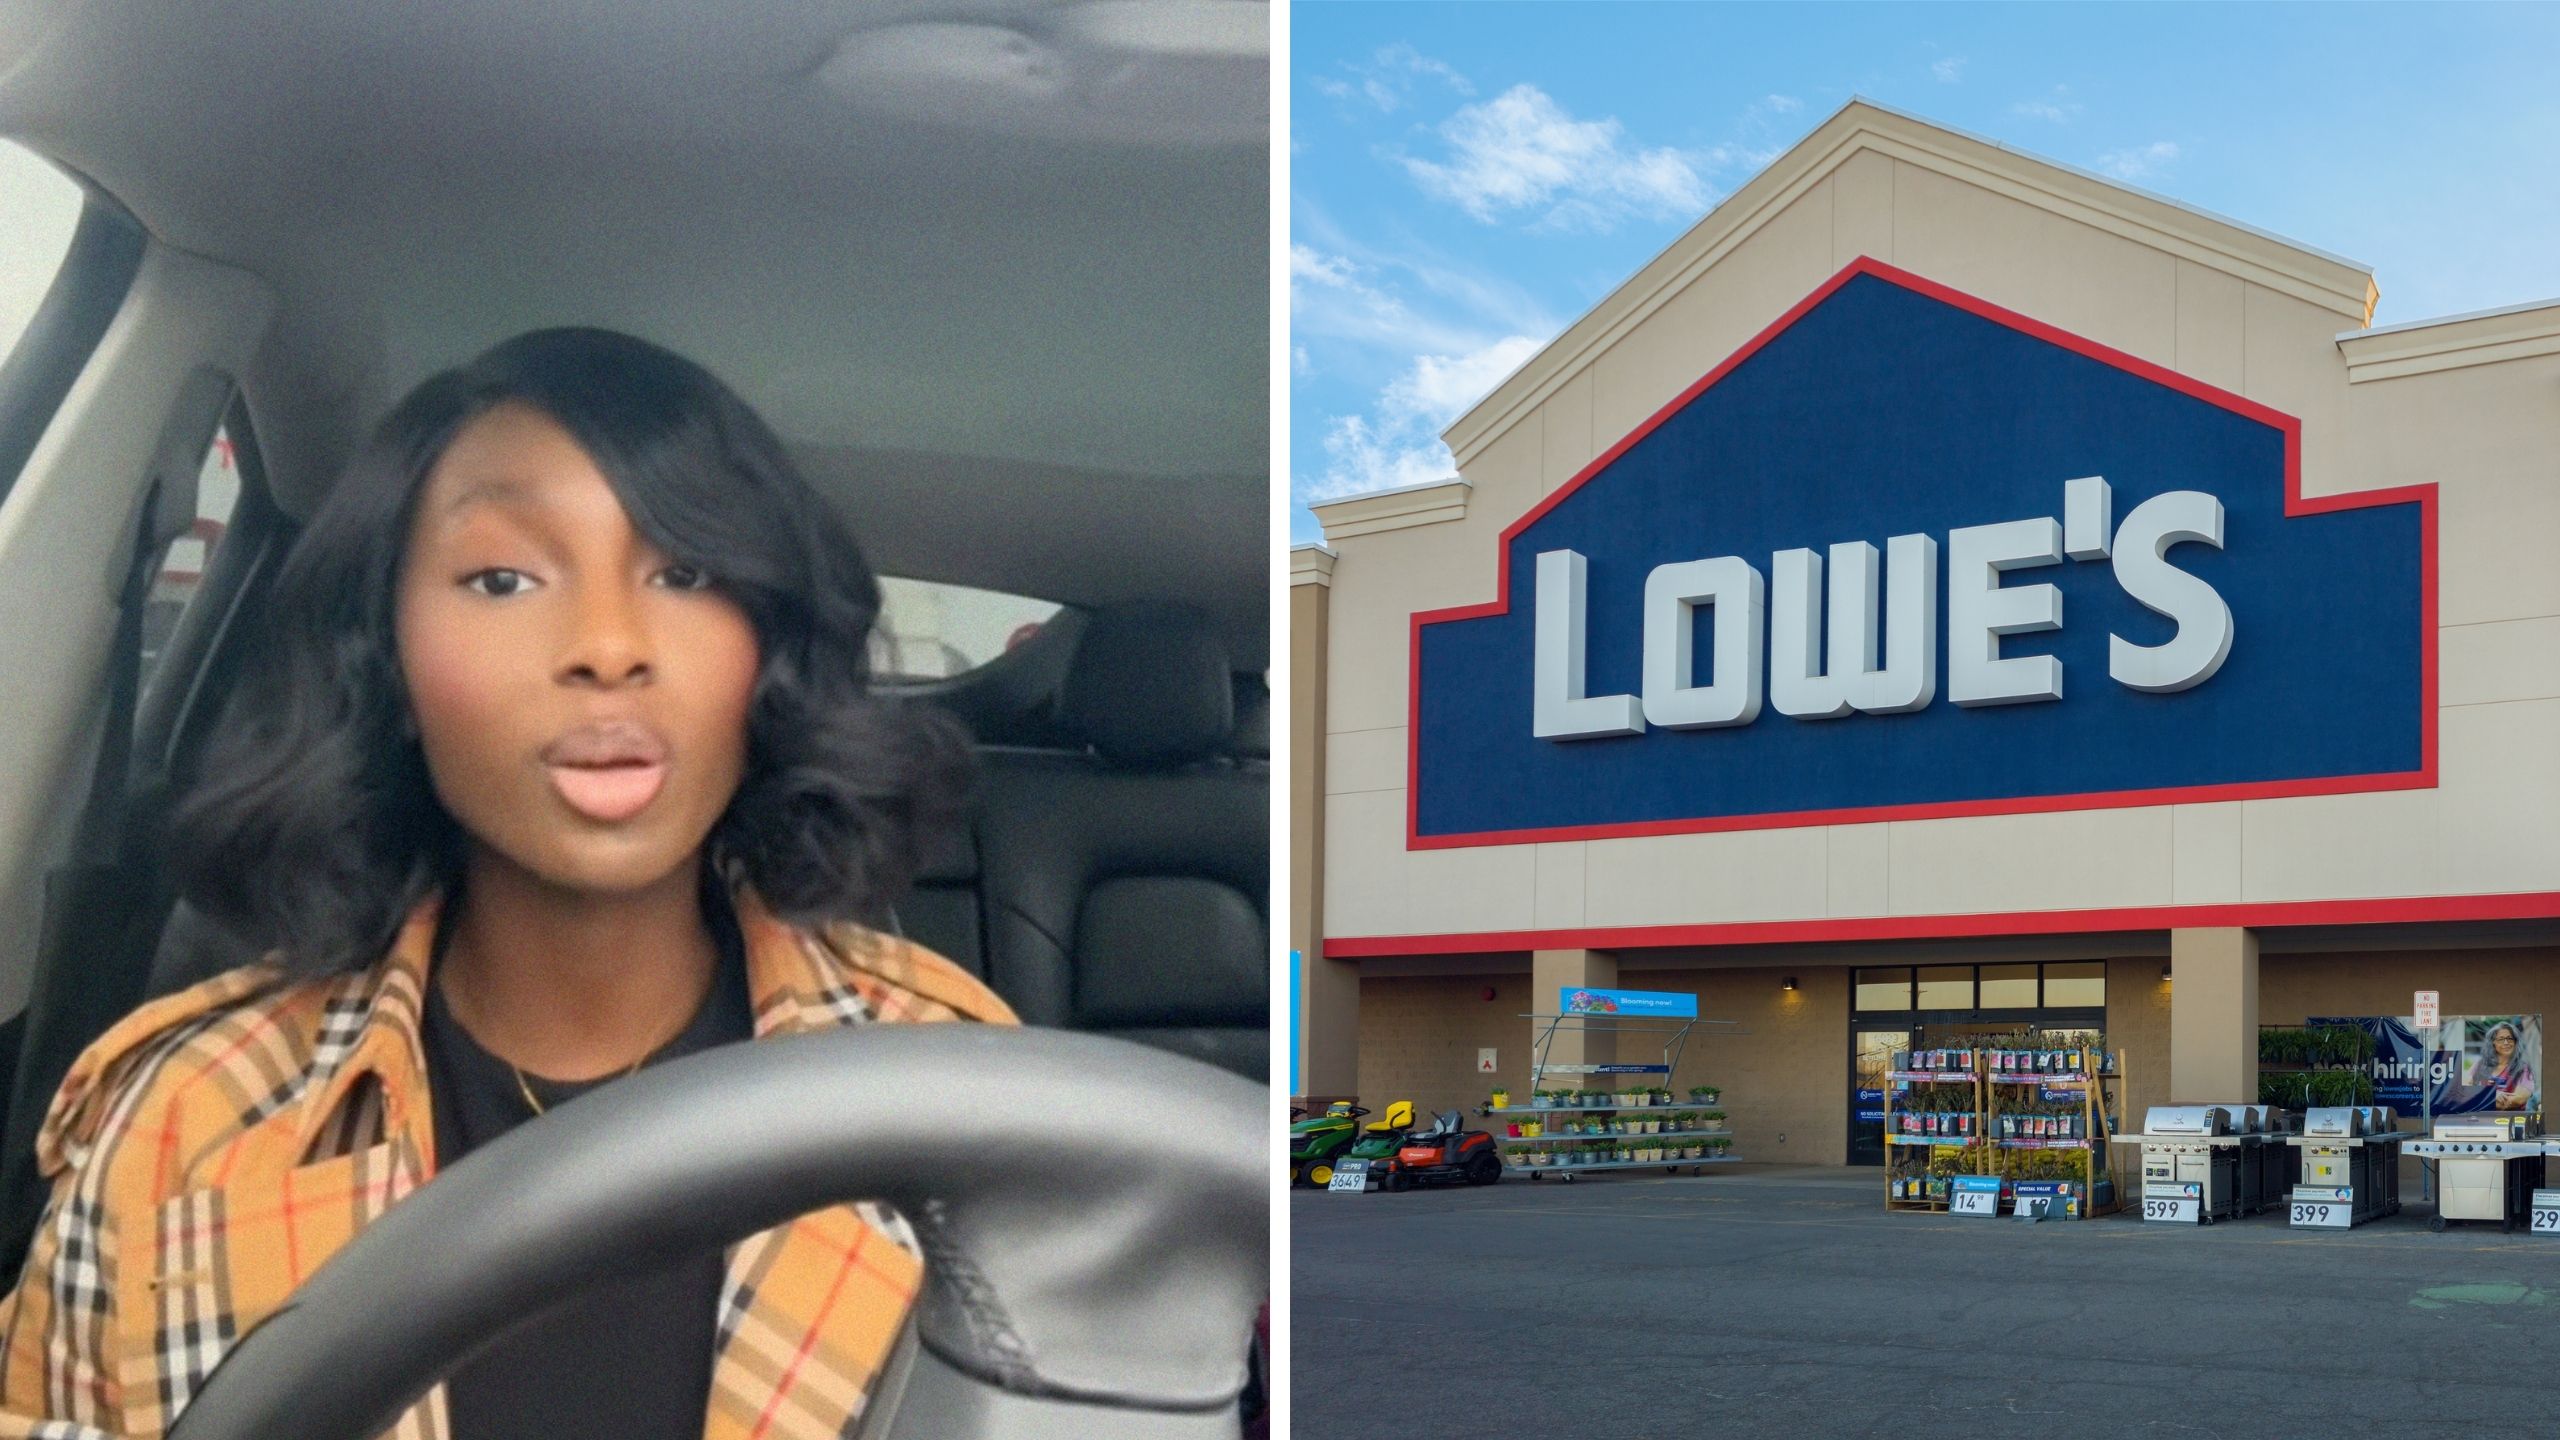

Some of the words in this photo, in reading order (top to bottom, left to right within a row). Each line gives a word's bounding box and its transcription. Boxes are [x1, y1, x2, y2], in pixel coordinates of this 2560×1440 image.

[1534, 476, 2234, 741] LOWE'S
[1620, 997, 1654, 1007] Blooming
[2373, 1056, 2454, 1084] hiring!
[1331, 1174, 1361, 1188] 3649
[1960, 1194, 1976, 1210] 14
[2146, 1201, 2179, 1218] 599
[2293, 1205, 2330, 1222] 399
